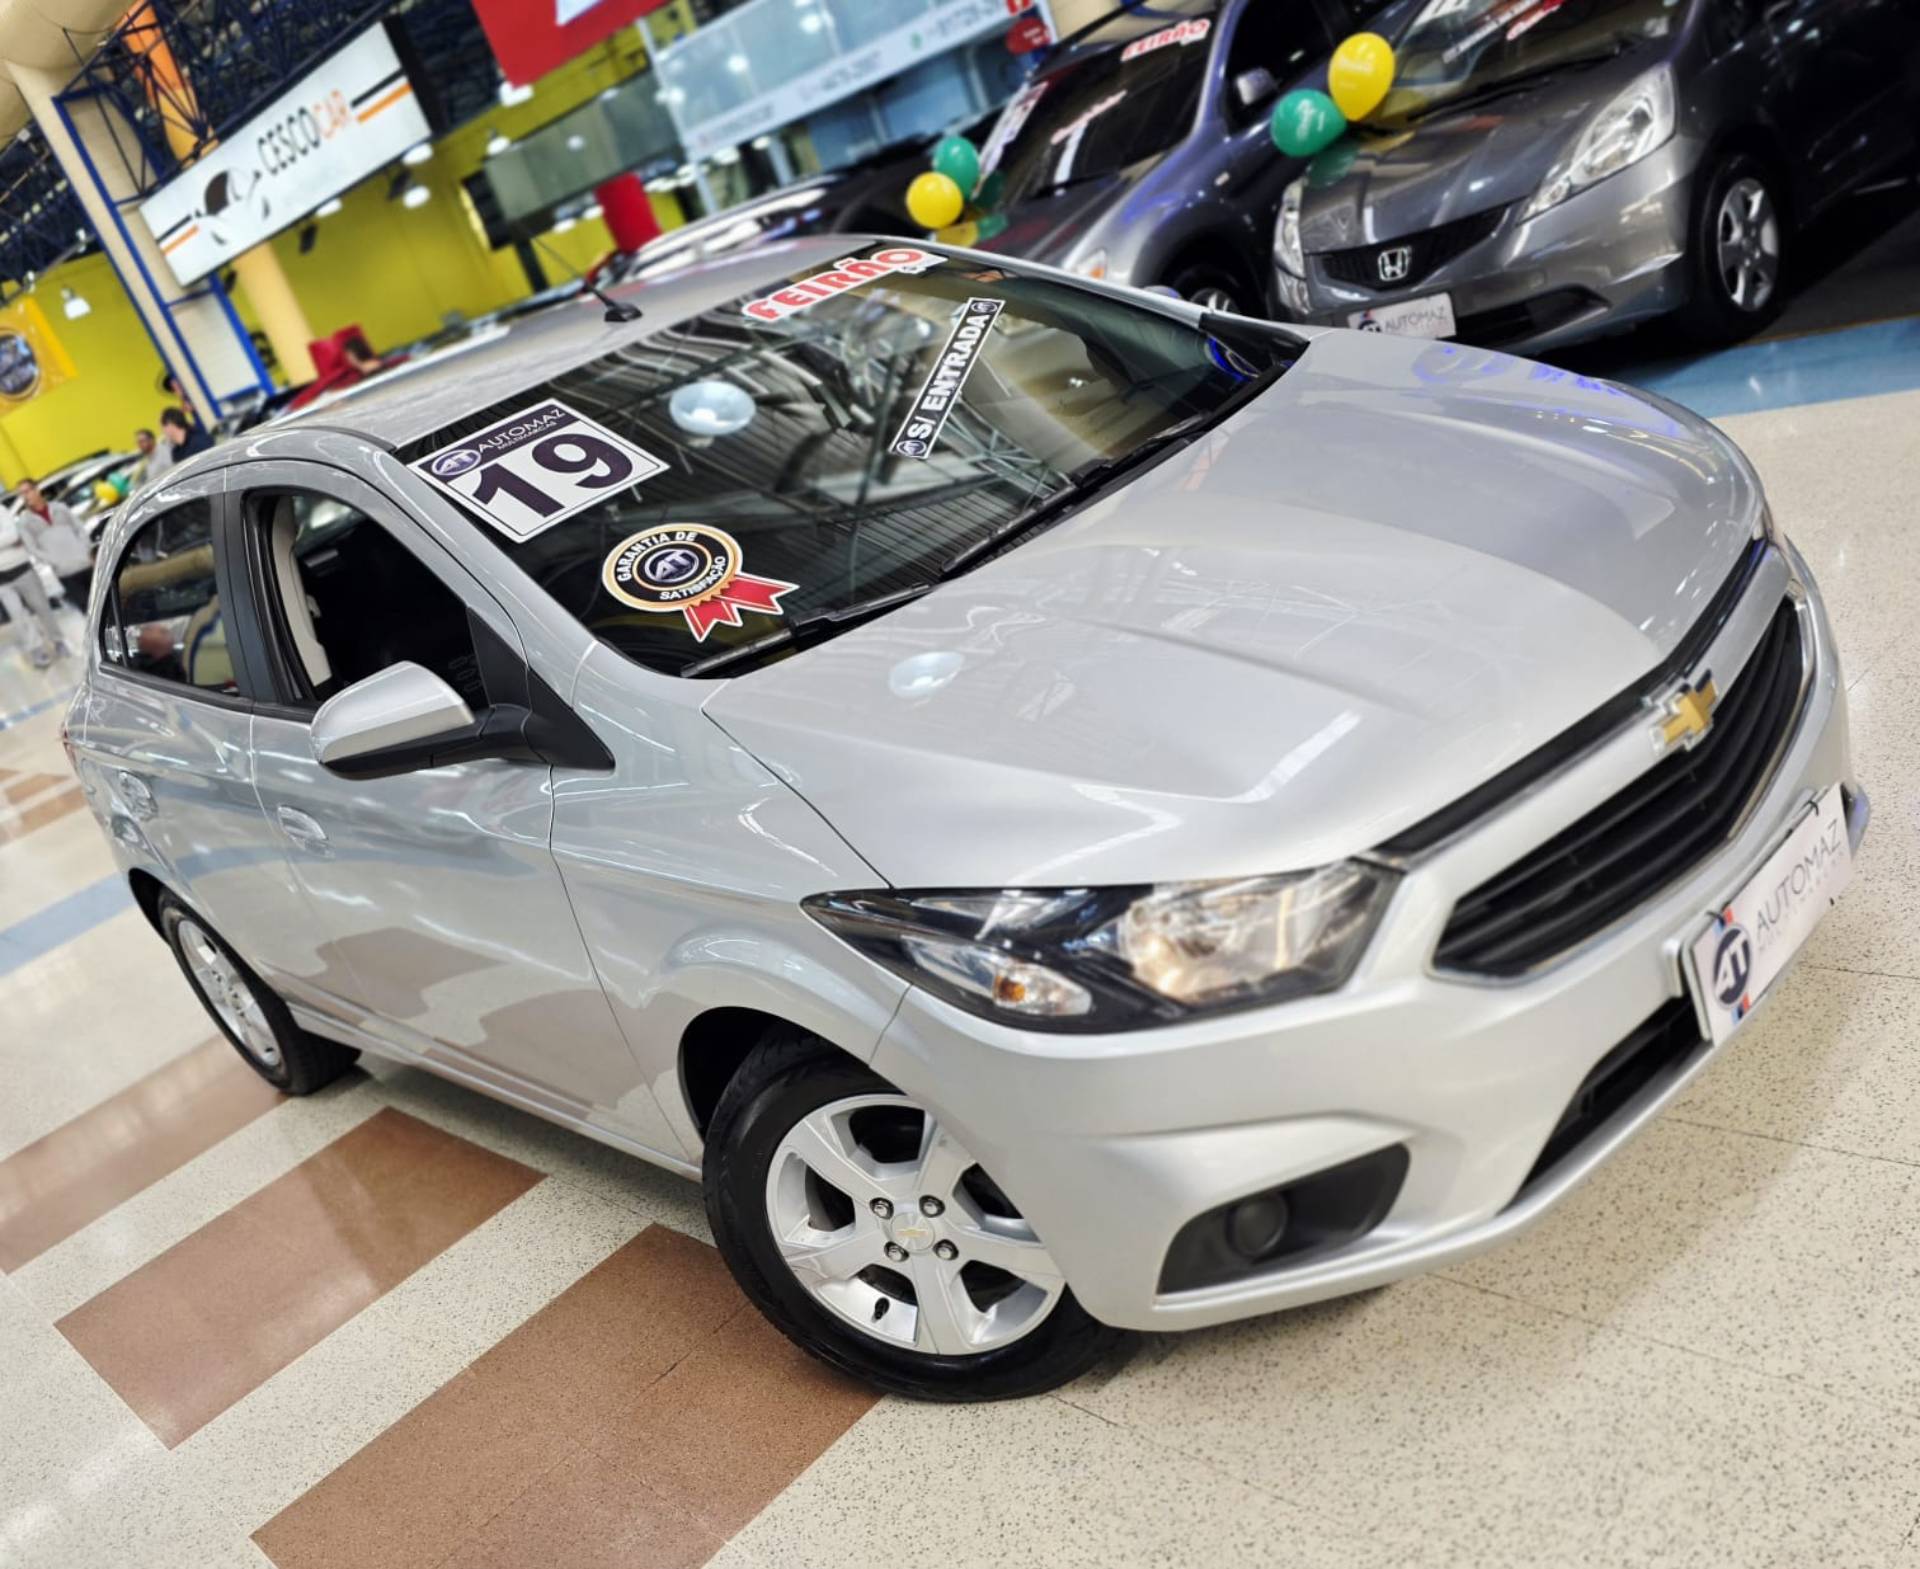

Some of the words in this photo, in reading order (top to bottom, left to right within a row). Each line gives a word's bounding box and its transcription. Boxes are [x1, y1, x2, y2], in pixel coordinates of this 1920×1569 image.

[745, 249, 924, 320] FEIRÃO
[921, 314, 990, 411] ENTRADA
[478, 408, 565, 453] AUTOMAZ
[907, 416, 936, 439] S/
[473, 433, 632, 518] 19
[617, 532, 670, 581] GARANTIA
[675, 531, 698, 542] DE
[1757, 818, 1841, 942] AUTOMAZ
